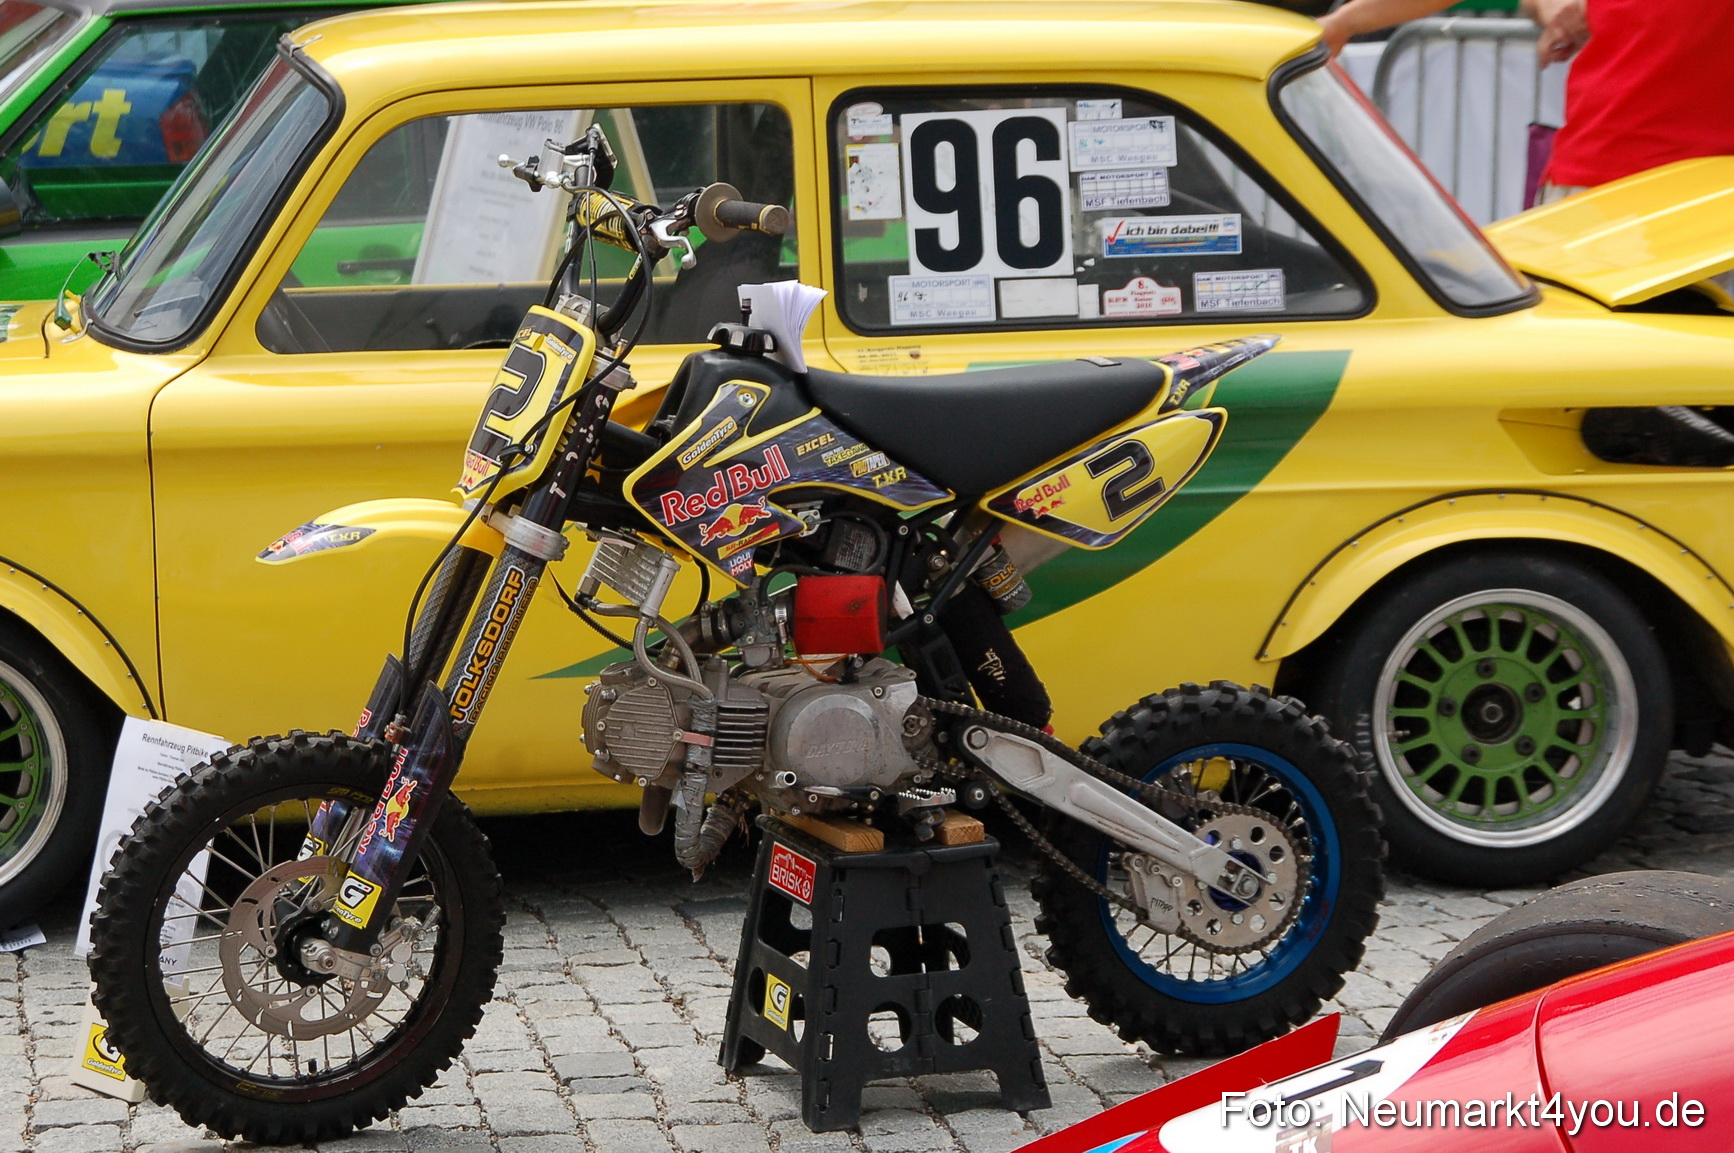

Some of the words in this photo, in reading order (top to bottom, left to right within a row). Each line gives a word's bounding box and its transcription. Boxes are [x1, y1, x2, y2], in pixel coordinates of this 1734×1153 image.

[910, 117, 1067, 273] 96
[1147, 224, 1168, 236] bin
[911, 279, 971, 289] MOTORSPORT
[468, 341, 546, 467] 2
[795, 432, 836, 457] EXCEL
[660, 470, 728, 527] Red
[726, 443, 791, 499] Bull
[1013, 488, 1044, 514] Red
[1043, 474, 1072, 499] Bull
[1083, 438, 1167, 523] 2
[142, 733, 186, 754] Rennfahrzeug
[186, 744, 209, 758] Pitbike
[771, 863, 803, 895] BRISK
